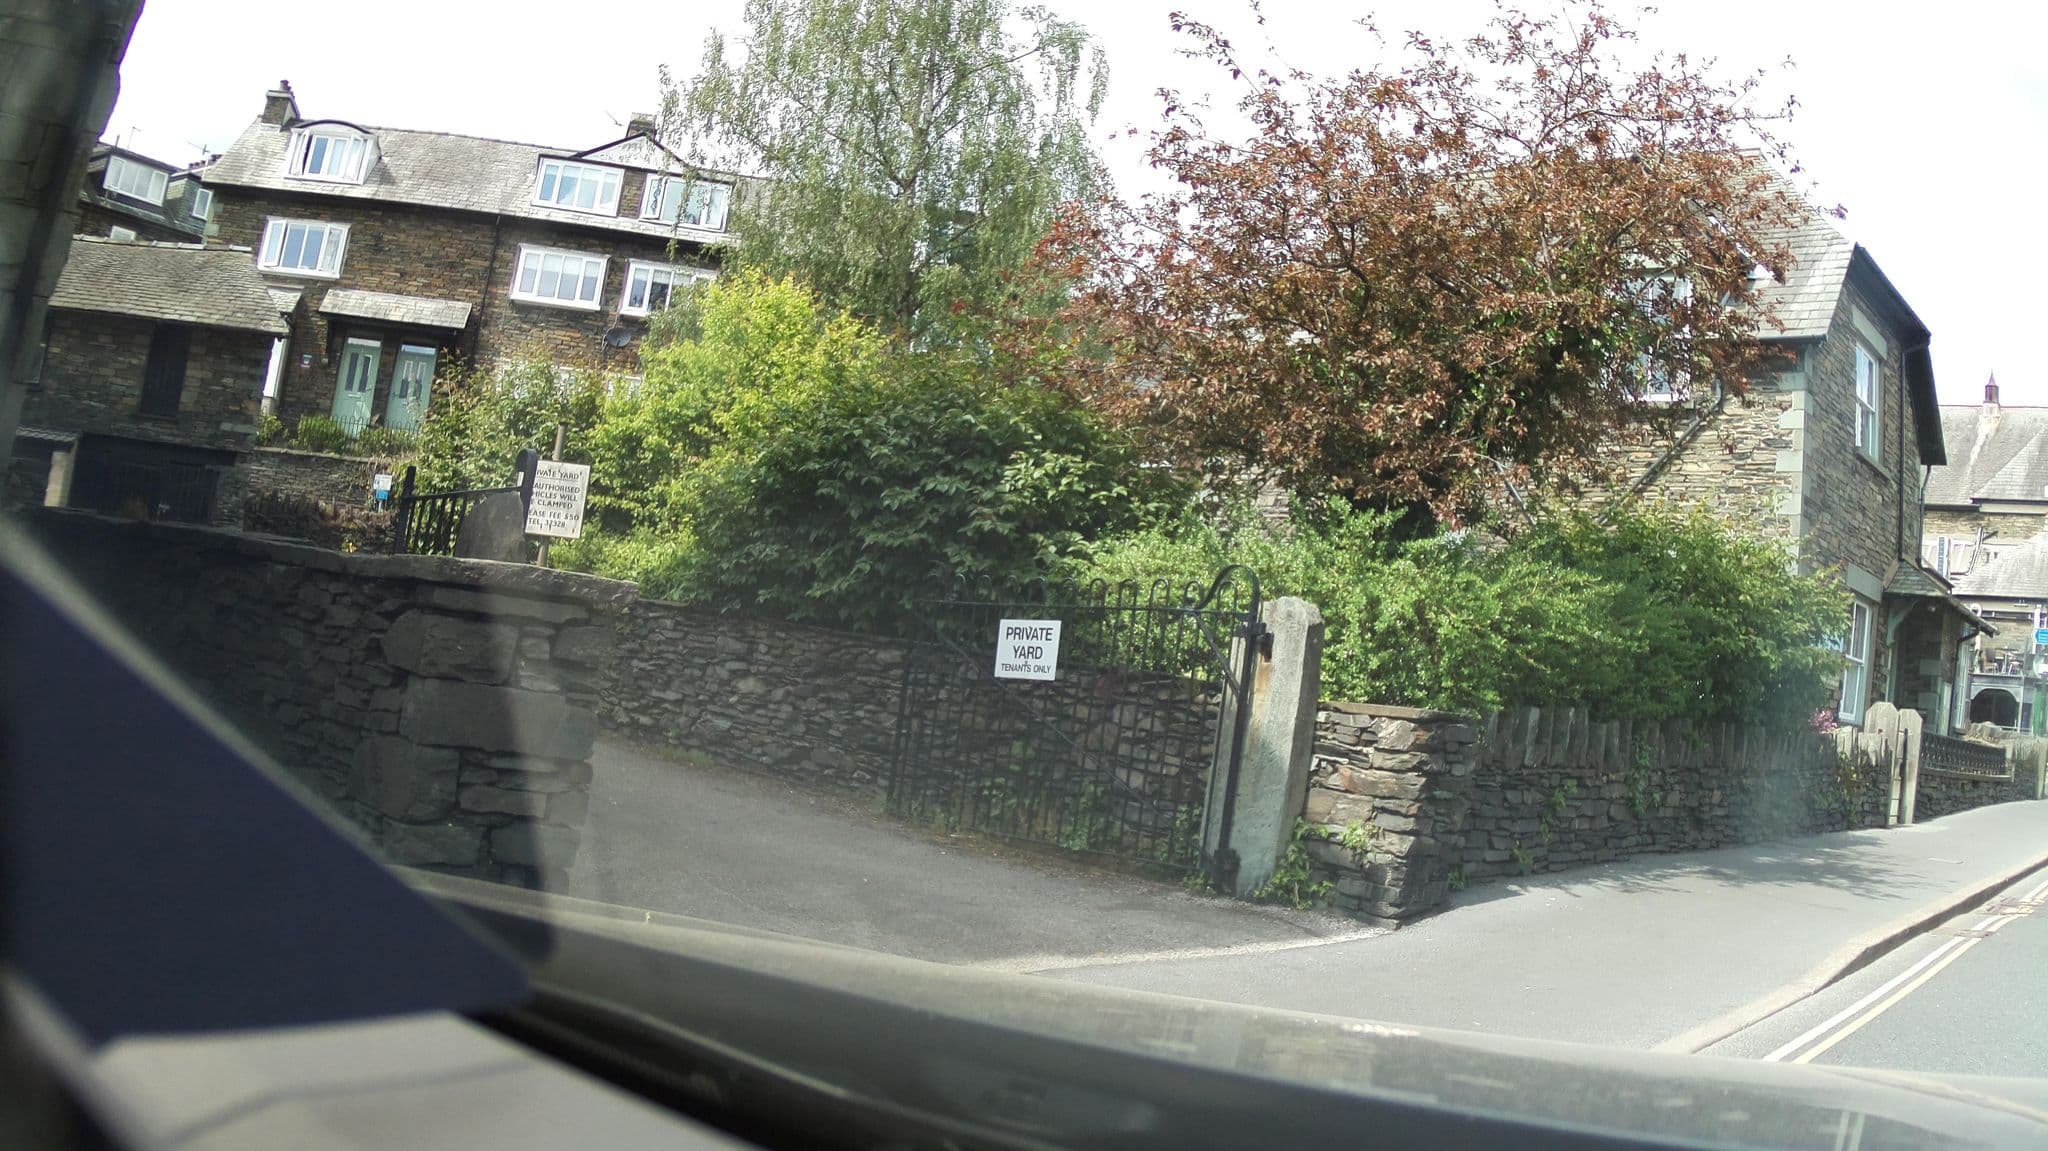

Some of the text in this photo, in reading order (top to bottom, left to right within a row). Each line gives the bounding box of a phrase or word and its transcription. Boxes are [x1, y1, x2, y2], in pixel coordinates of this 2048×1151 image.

[537, 499, 573, 509] CLAMPED
[549, 511, 562, 519] FEE
[1006, 626, 1054, 641] PRIVATE
[1013, 645, 1043, 660] YARD
[1001, 663, 1052, 674] TENANTS ONLY
